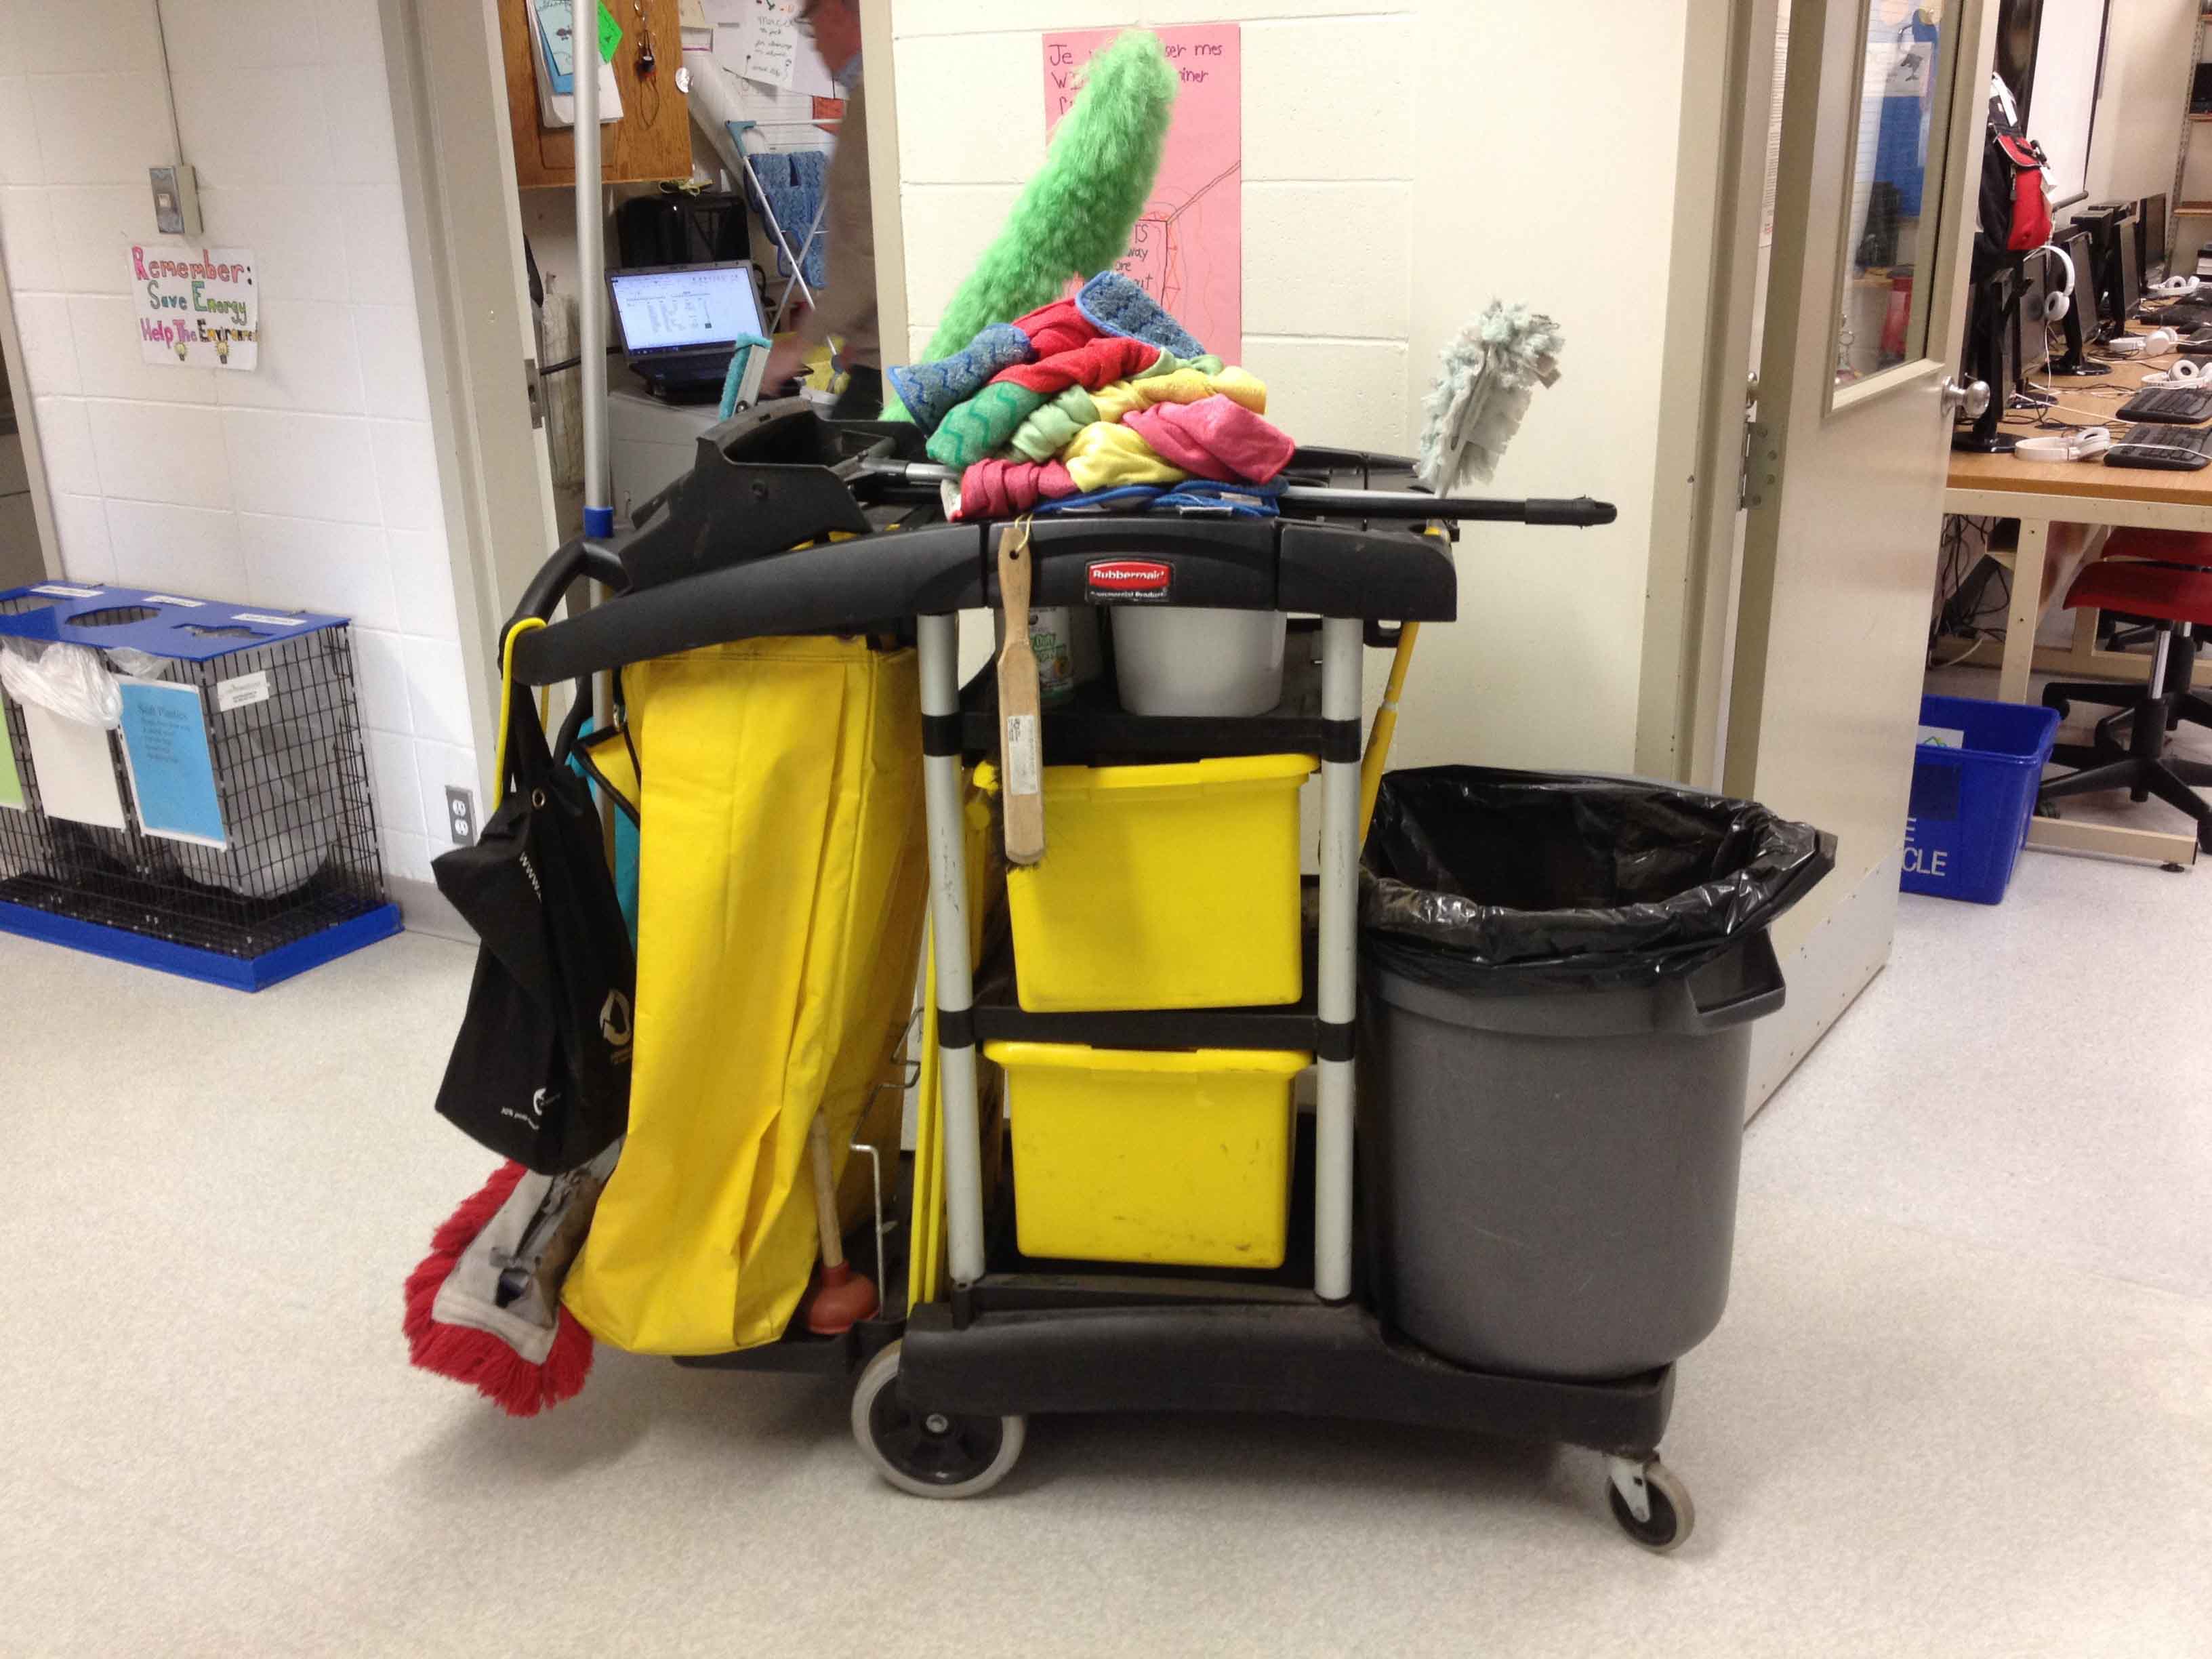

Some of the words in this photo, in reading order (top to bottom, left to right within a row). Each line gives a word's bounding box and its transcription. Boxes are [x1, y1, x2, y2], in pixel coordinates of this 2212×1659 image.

[1048, 43, 1073, 66] Je
[1194, 43, 1223, 56] mes
[131, 245, 252, 285] Remember:
[147, 279, 188, 310] Save
[191, 281, 247, 325] Energy
[140, 317, 174, 350] Help
[172, 319, 198, 342] The
